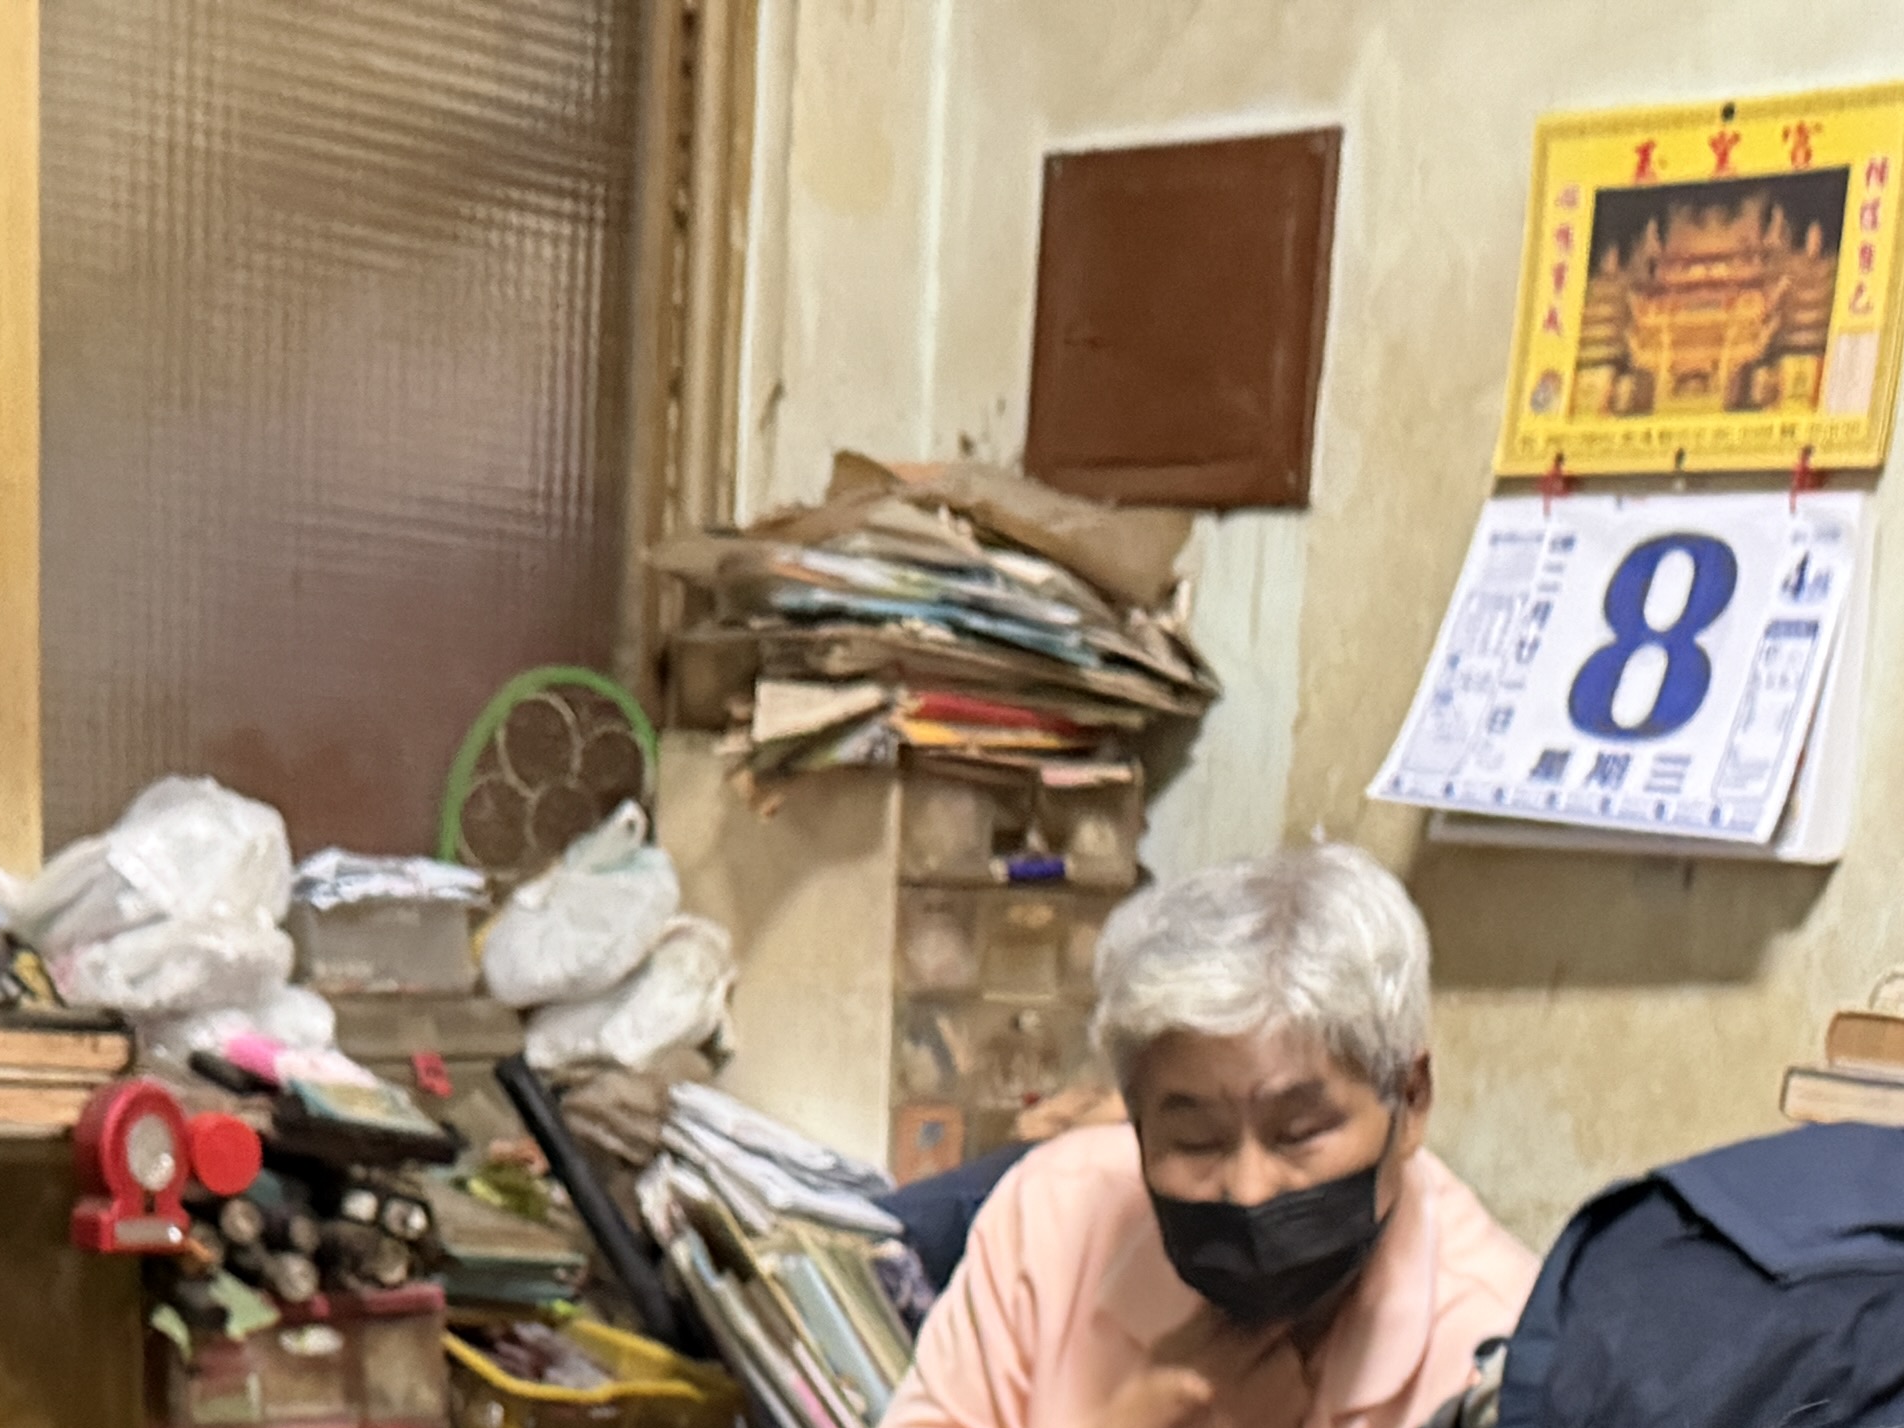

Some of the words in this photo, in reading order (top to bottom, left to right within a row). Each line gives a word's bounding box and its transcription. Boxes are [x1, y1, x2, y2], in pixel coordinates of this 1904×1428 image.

[1569, 532, 1739, 742] 8
[1528, 747, 1694, 793] 星期三
